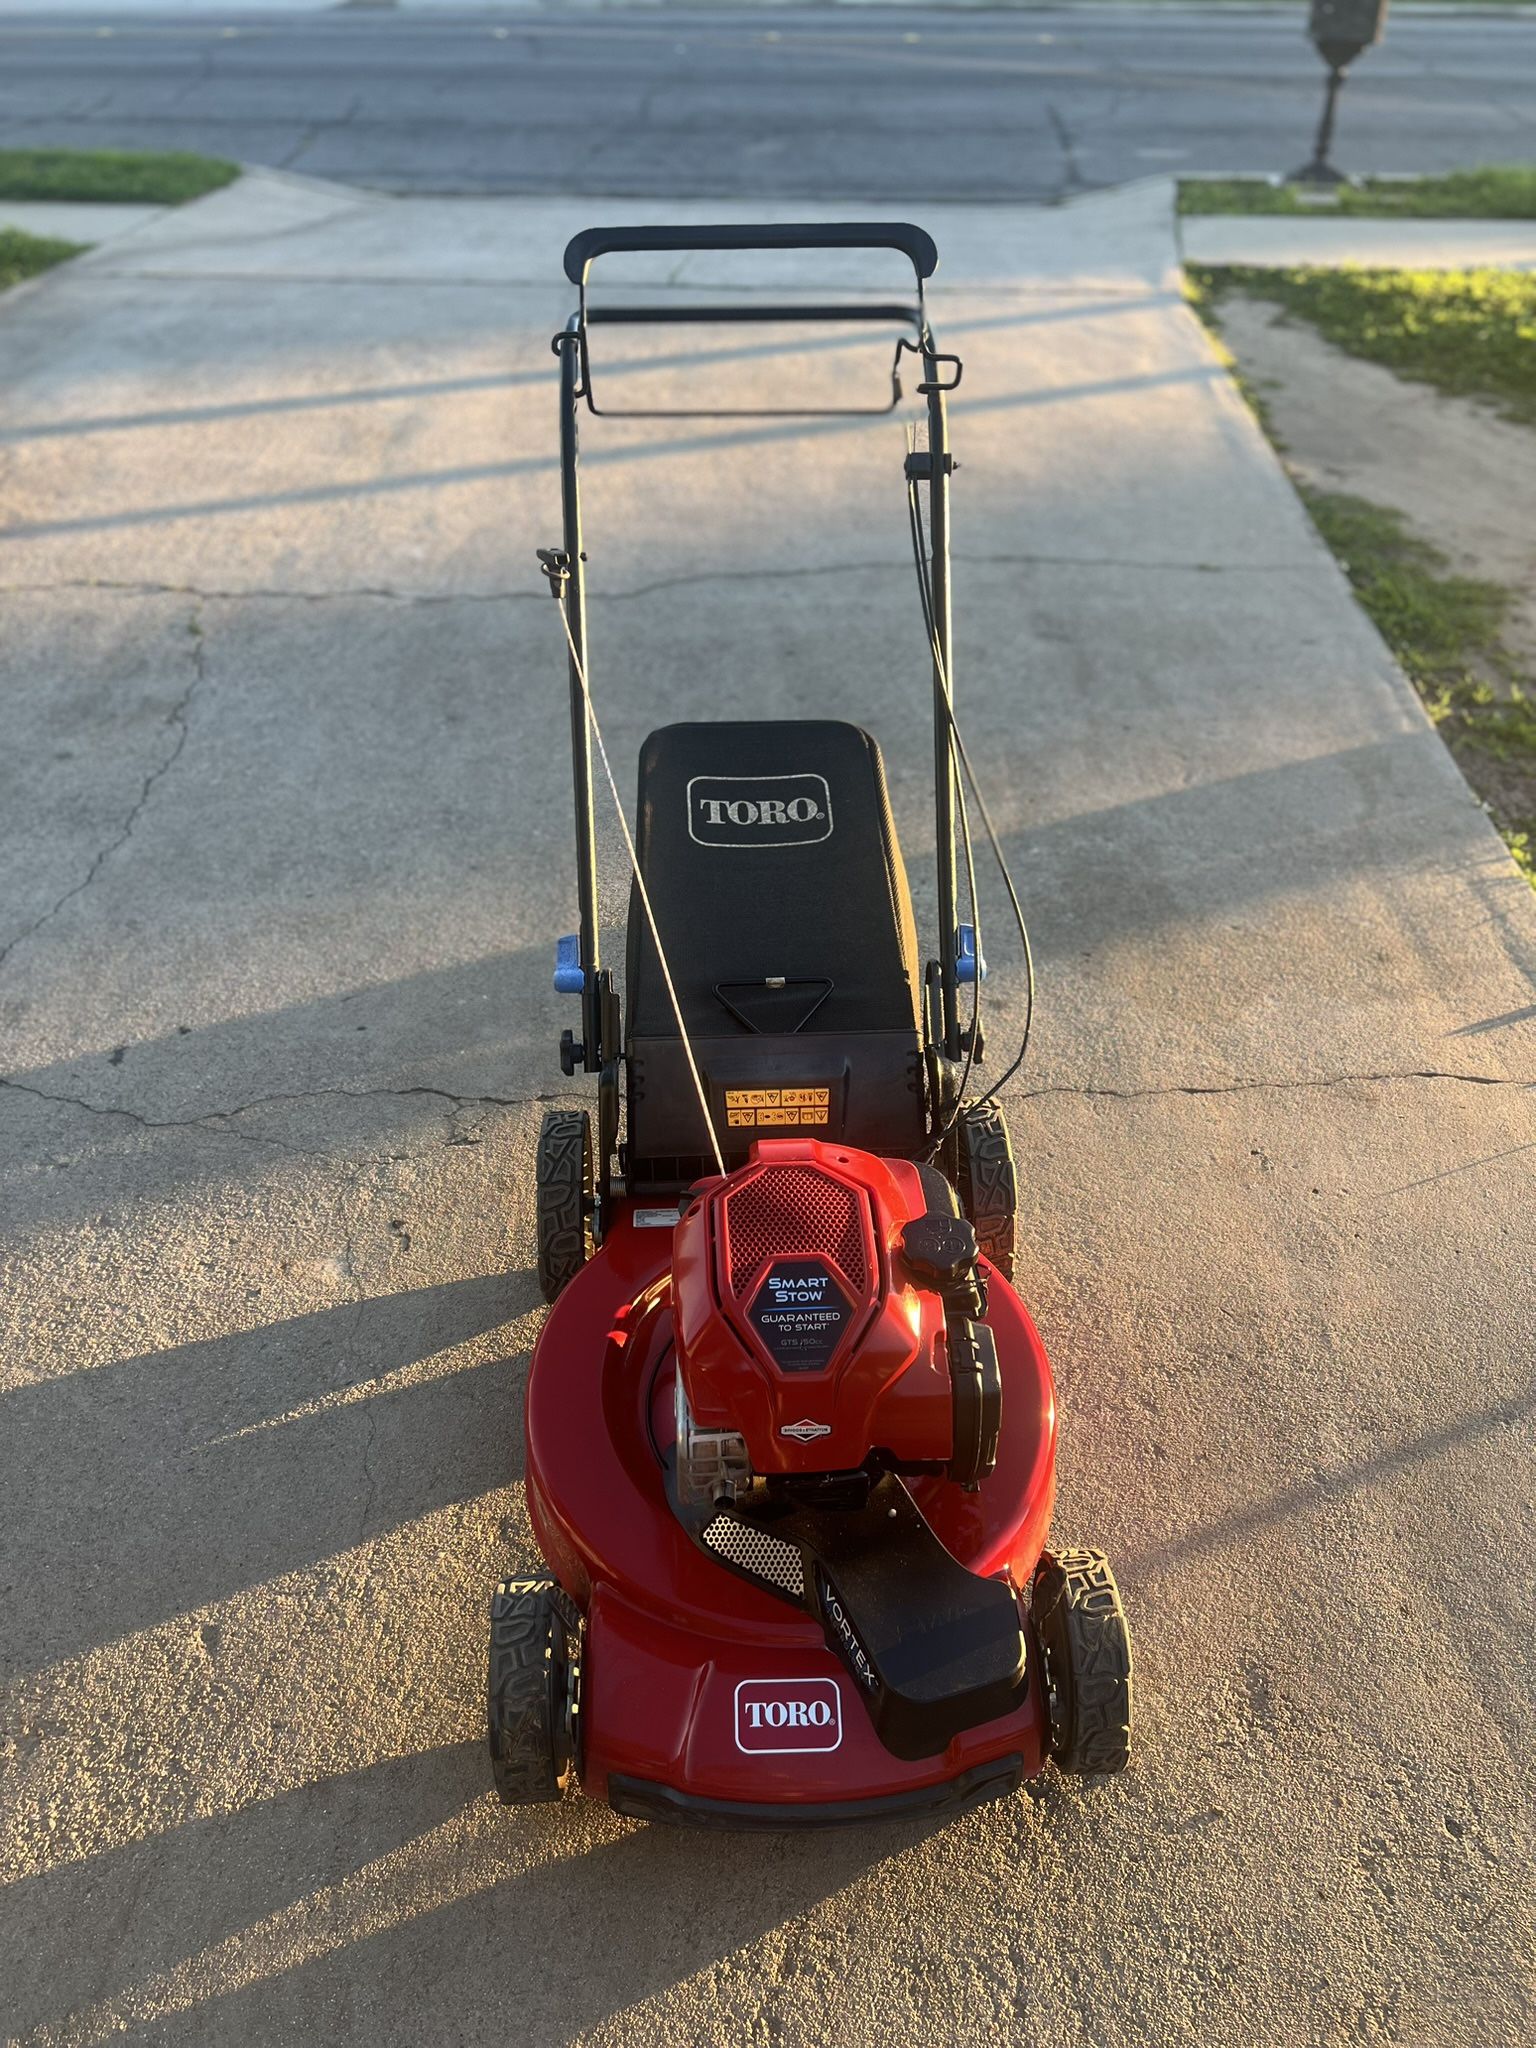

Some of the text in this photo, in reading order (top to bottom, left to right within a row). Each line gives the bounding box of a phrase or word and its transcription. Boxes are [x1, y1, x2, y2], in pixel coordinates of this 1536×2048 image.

[700, 797, 818, 825] TORO
[768, 1277, 828, 1289] SMART
[775, 1290, 823, 1303] STOW
[761, 1312, 841, 1323] GUARANTEED
[779, 1322, 827, 1332] TO START
[826, 1584, 875, 1685] VORTEX
[745, 1700, 832, 1727] TORO
